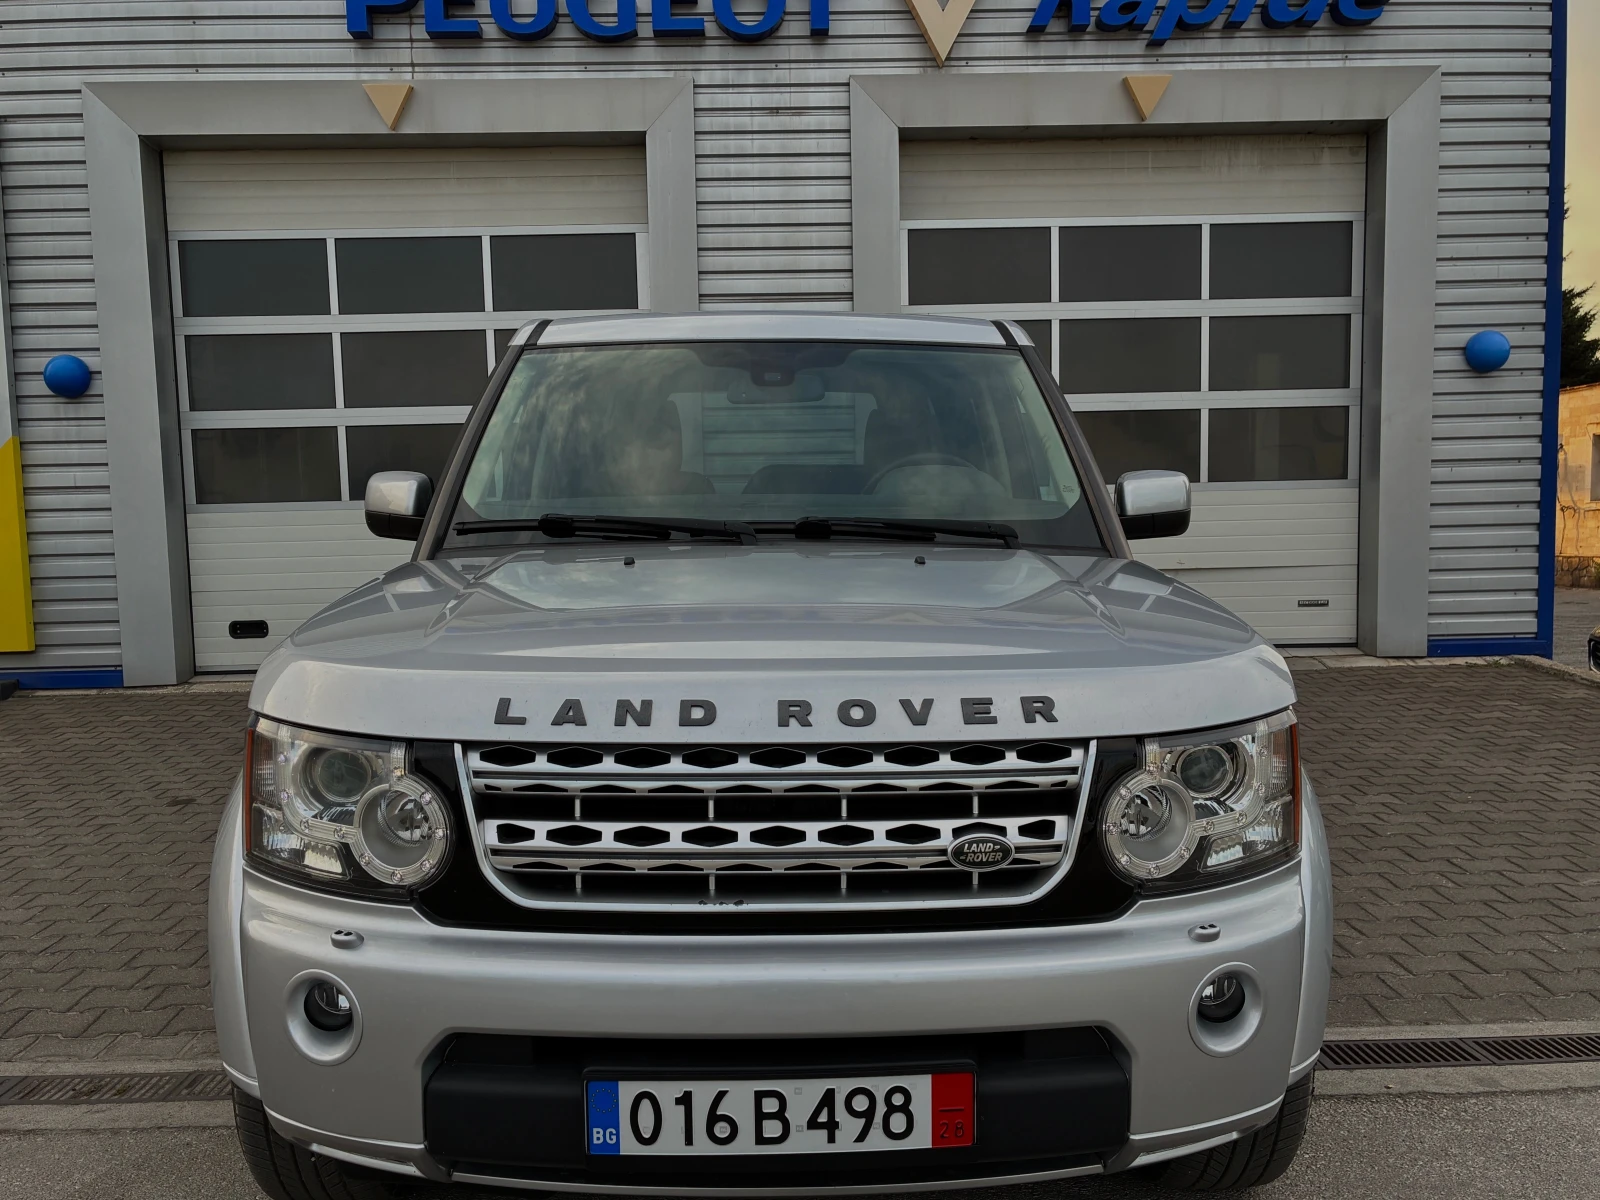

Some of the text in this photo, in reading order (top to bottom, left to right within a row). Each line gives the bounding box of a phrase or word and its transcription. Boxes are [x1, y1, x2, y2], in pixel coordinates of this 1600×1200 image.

[494, 696, 1059, 727] LAND ROVER
[963, 843, 994, 853] LAND
[966, 852, 1003, 862] ROVER
[592, 1127, 617, 1144] BG
[939, 1119, 965, 1139] 28
